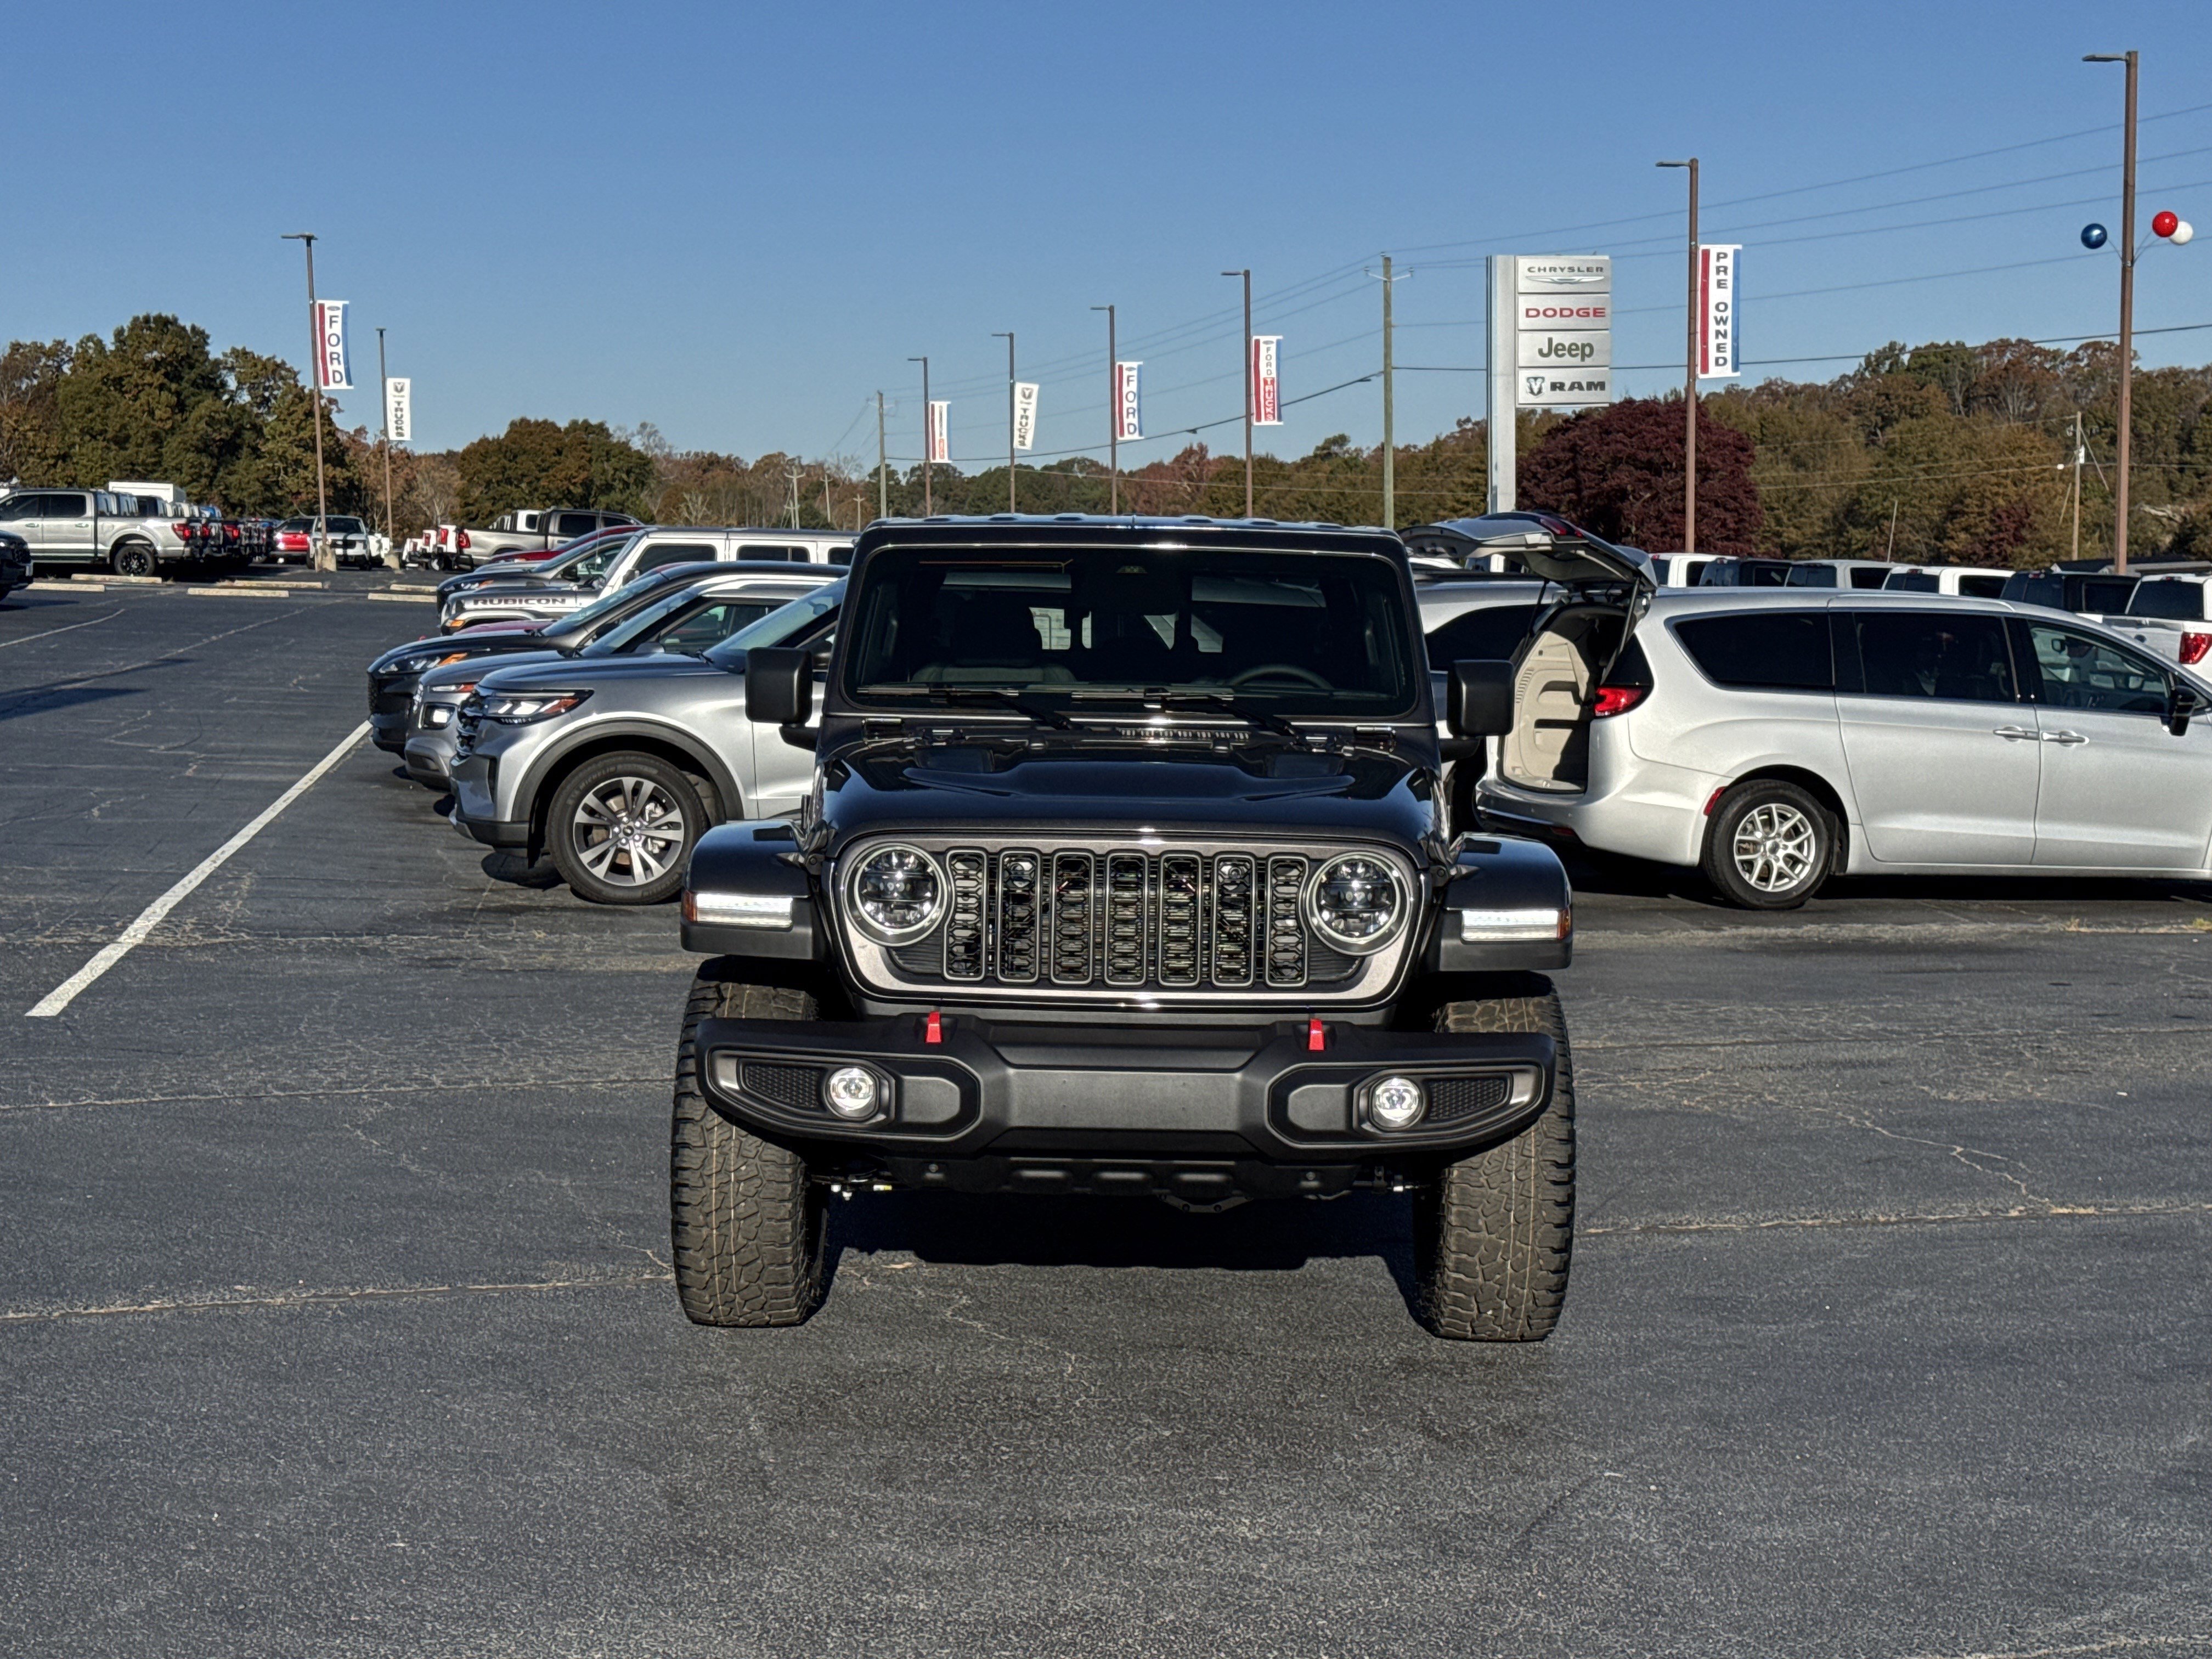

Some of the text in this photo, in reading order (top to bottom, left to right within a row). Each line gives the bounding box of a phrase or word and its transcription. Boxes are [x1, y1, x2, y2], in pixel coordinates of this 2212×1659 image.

[1525, 307, 1606, 318] DODGE
[1713, 252, 1729, 366] PRE OWNED
[328, 315, 343, 383] FORD
[1538, 337, 1594, 362] Jeep
[1125, 375, 1137, 435] FORD
[1265, 378, 1274, 420] TRUCKS
[1550, 381, 1605, 391] RAM
[394, 401, 405, 437] TRUCKS
[1018, 408, 1029, 446] TRUCKS
